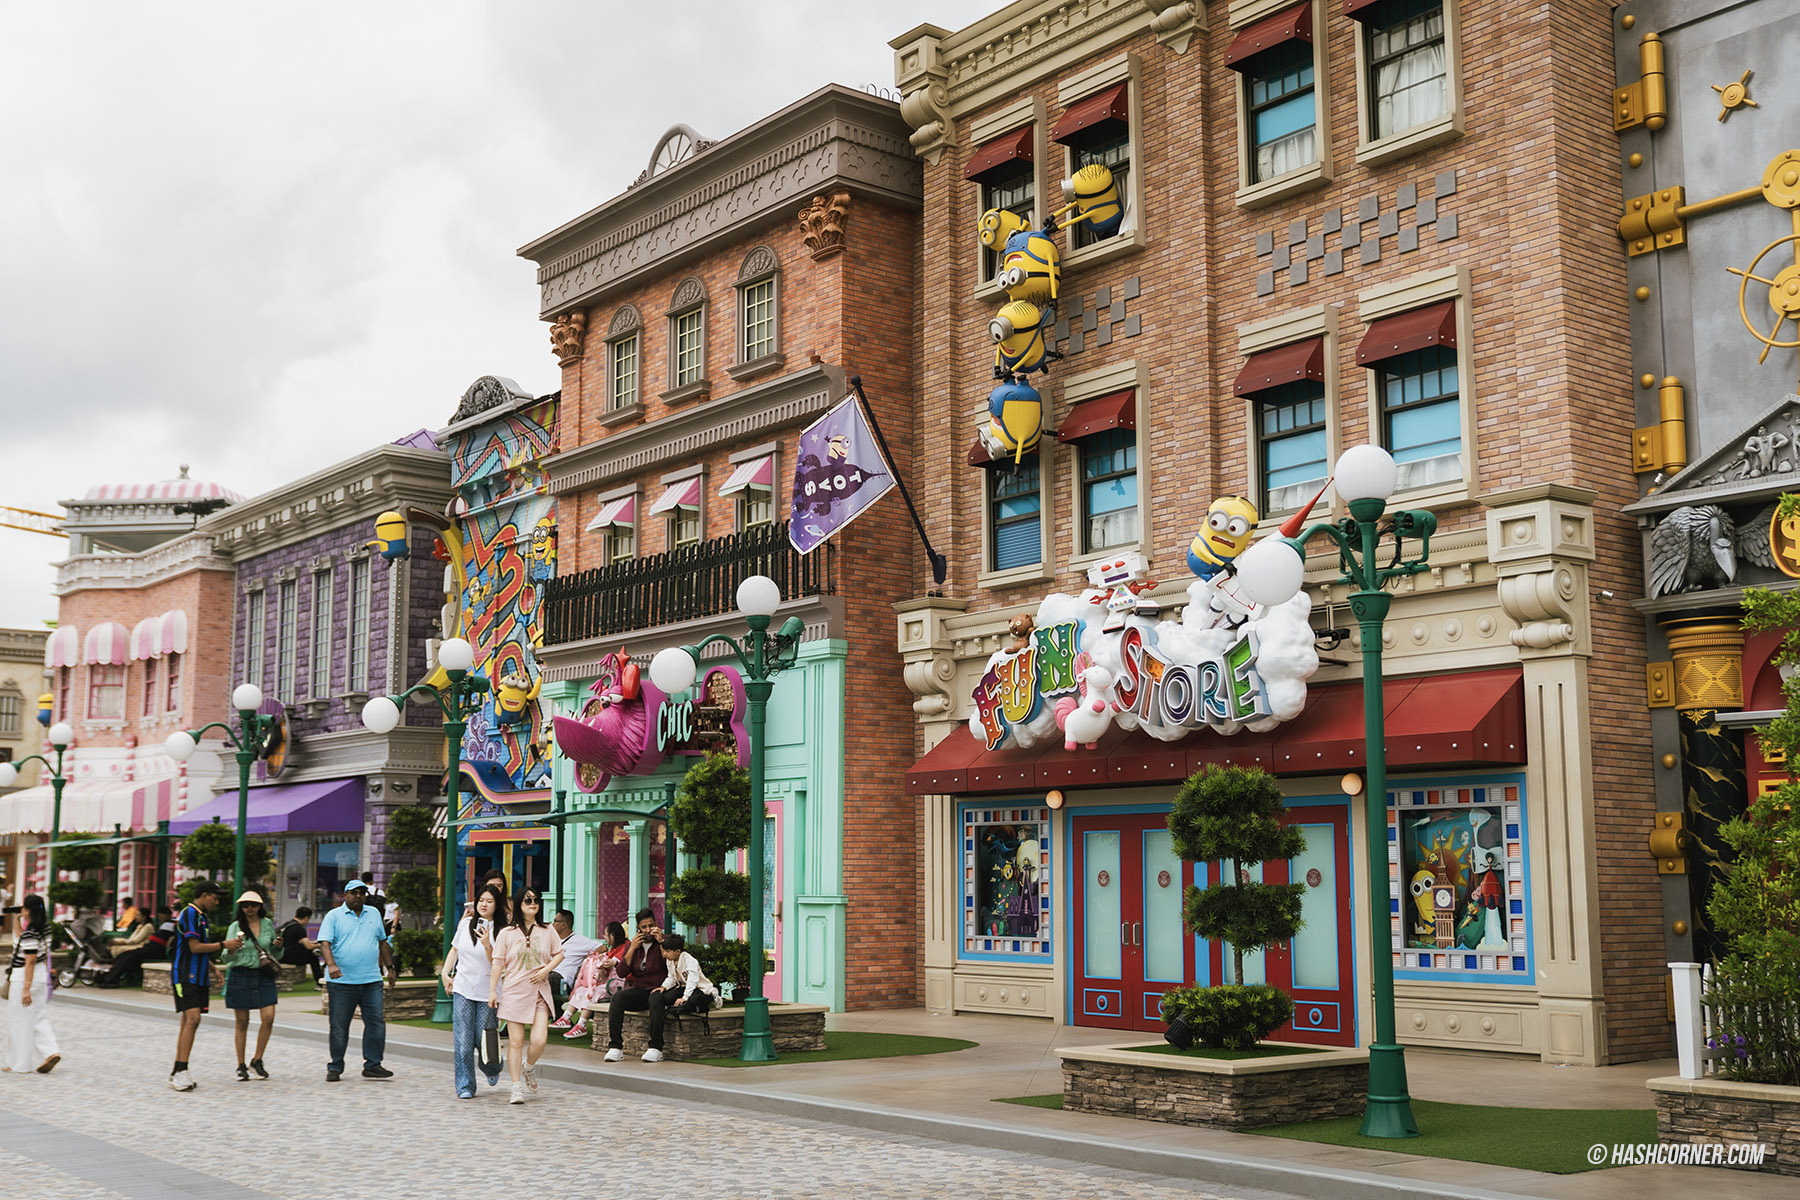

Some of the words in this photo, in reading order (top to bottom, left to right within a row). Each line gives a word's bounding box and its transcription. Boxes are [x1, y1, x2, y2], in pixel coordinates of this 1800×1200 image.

[804, 470, 863, 497] TOYS
[972, 618, 1083, 751] FUN
[1114, 627, 1270, 728] STORE
[657, 700, 693, 752] CHIC
